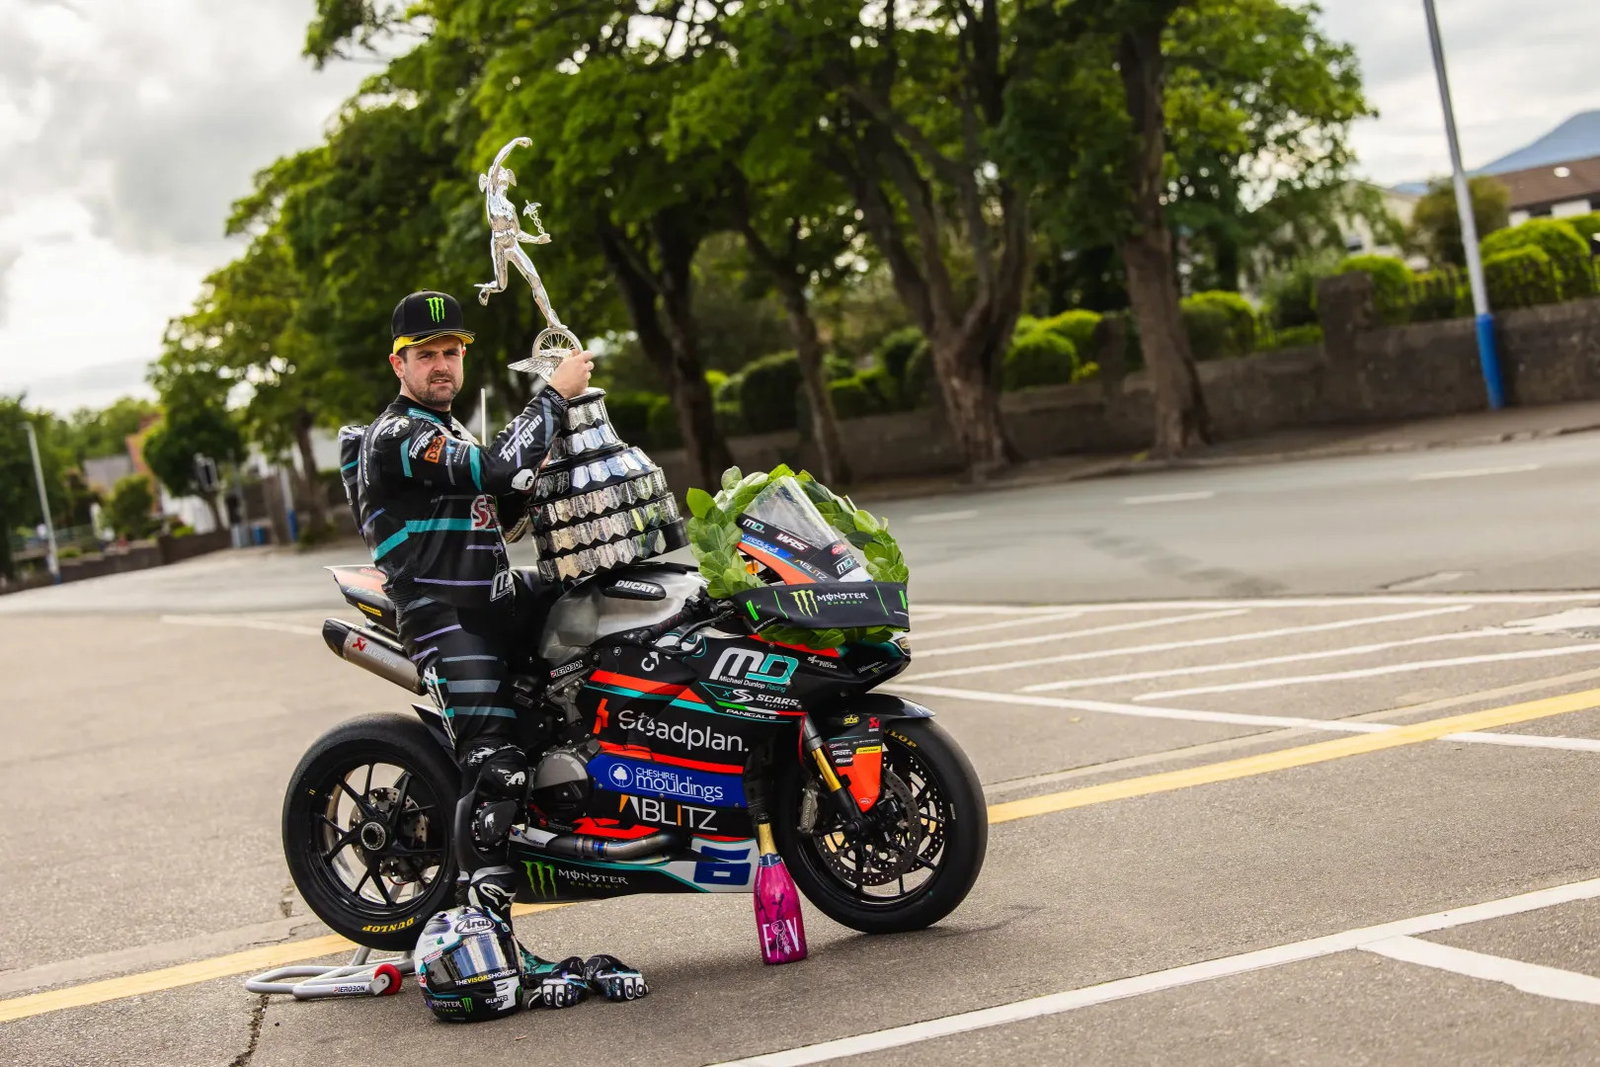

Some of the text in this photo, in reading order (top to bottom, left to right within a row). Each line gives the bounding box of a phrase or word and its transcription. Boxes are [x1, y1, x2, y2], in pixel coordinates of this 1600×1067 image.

[499, 414, 544, 463] furygan
[615, 579, 658, 594] DUCATI
[709, 647, 799, 685] MD
[719, 675, 787, 693] Michael Dunlop Racing
[756, 694, 800, 706] SCARS
[726, 708, 777, 720] PANIGALE
[843, 714, 860, 726] sbs
[636, 767, 676, 780] CHESHIRE
[636, 774, 723, 802] mouldings
[362, 917, 415, 933] DUNLOP
[461, 919, 491, 930] Arai
[333, 985, 366, 993] PIEROBON
